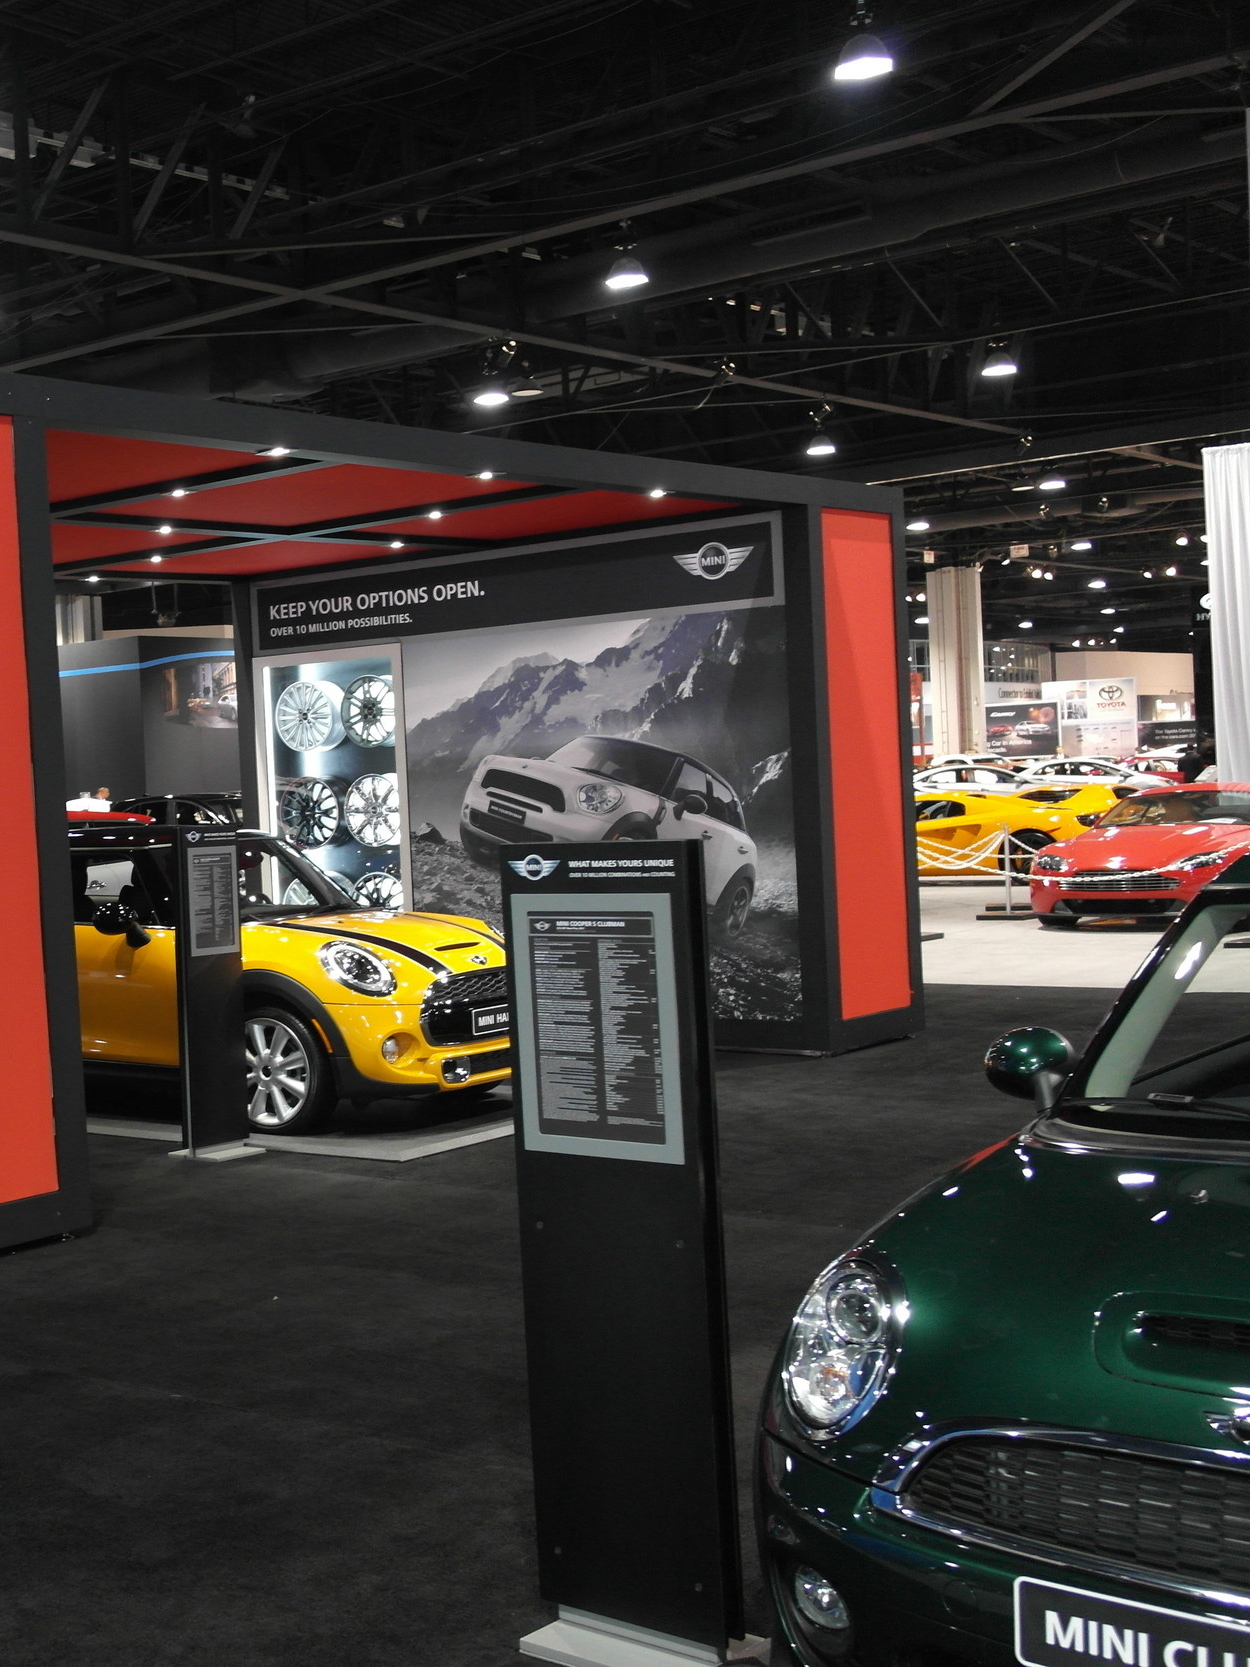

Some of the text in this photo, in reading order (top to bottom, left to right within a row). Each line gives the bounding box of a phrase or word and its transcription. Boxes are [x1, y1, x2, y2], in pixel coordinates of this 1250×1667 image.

[700, 554, 726, 568] MINI
[269, 579, 486, 621] KEEP YOUR OPTIONS OPEN.
[269, 612, 414, 638] OVER 10 MILLION POSSIBILITIES.
[1096, 701, 1127, 709] TOYOTA
[526, 863, 542, 871] MINI
[568, 860, 590, 868] WHAT
[617, 859, 643, 867] YOURS
[643, 859, 674, 868] UNIQUE
[478, 1014, 495, 1027] MINI
[1044, 1609, 1149, 1667] MINI
